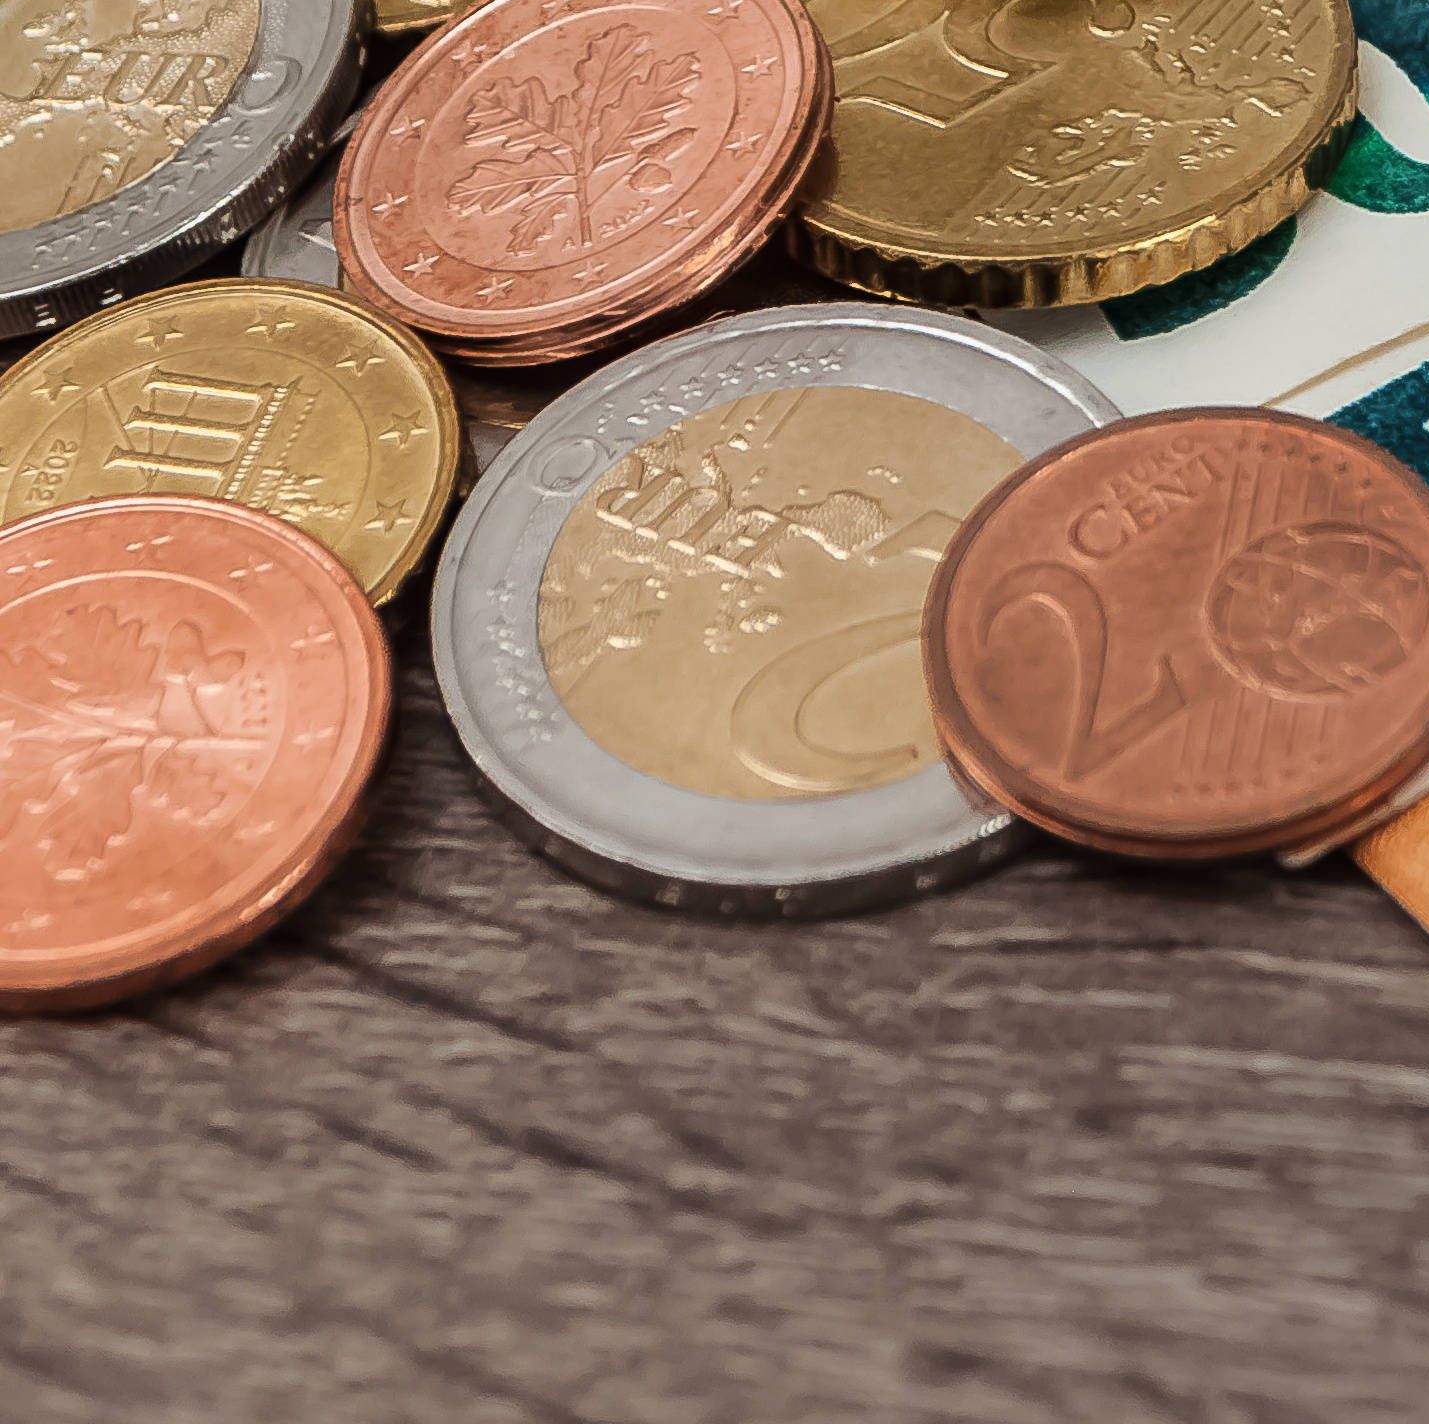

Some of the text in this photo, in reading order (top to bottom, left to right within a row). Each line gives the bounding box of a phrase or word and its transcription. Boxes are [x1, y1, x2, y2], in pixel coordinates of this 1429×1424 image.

[38, 50, 303, 118] EURO
[1066, 444, 1228, 561] CENT
[975, 560, 1189, 784] 2
